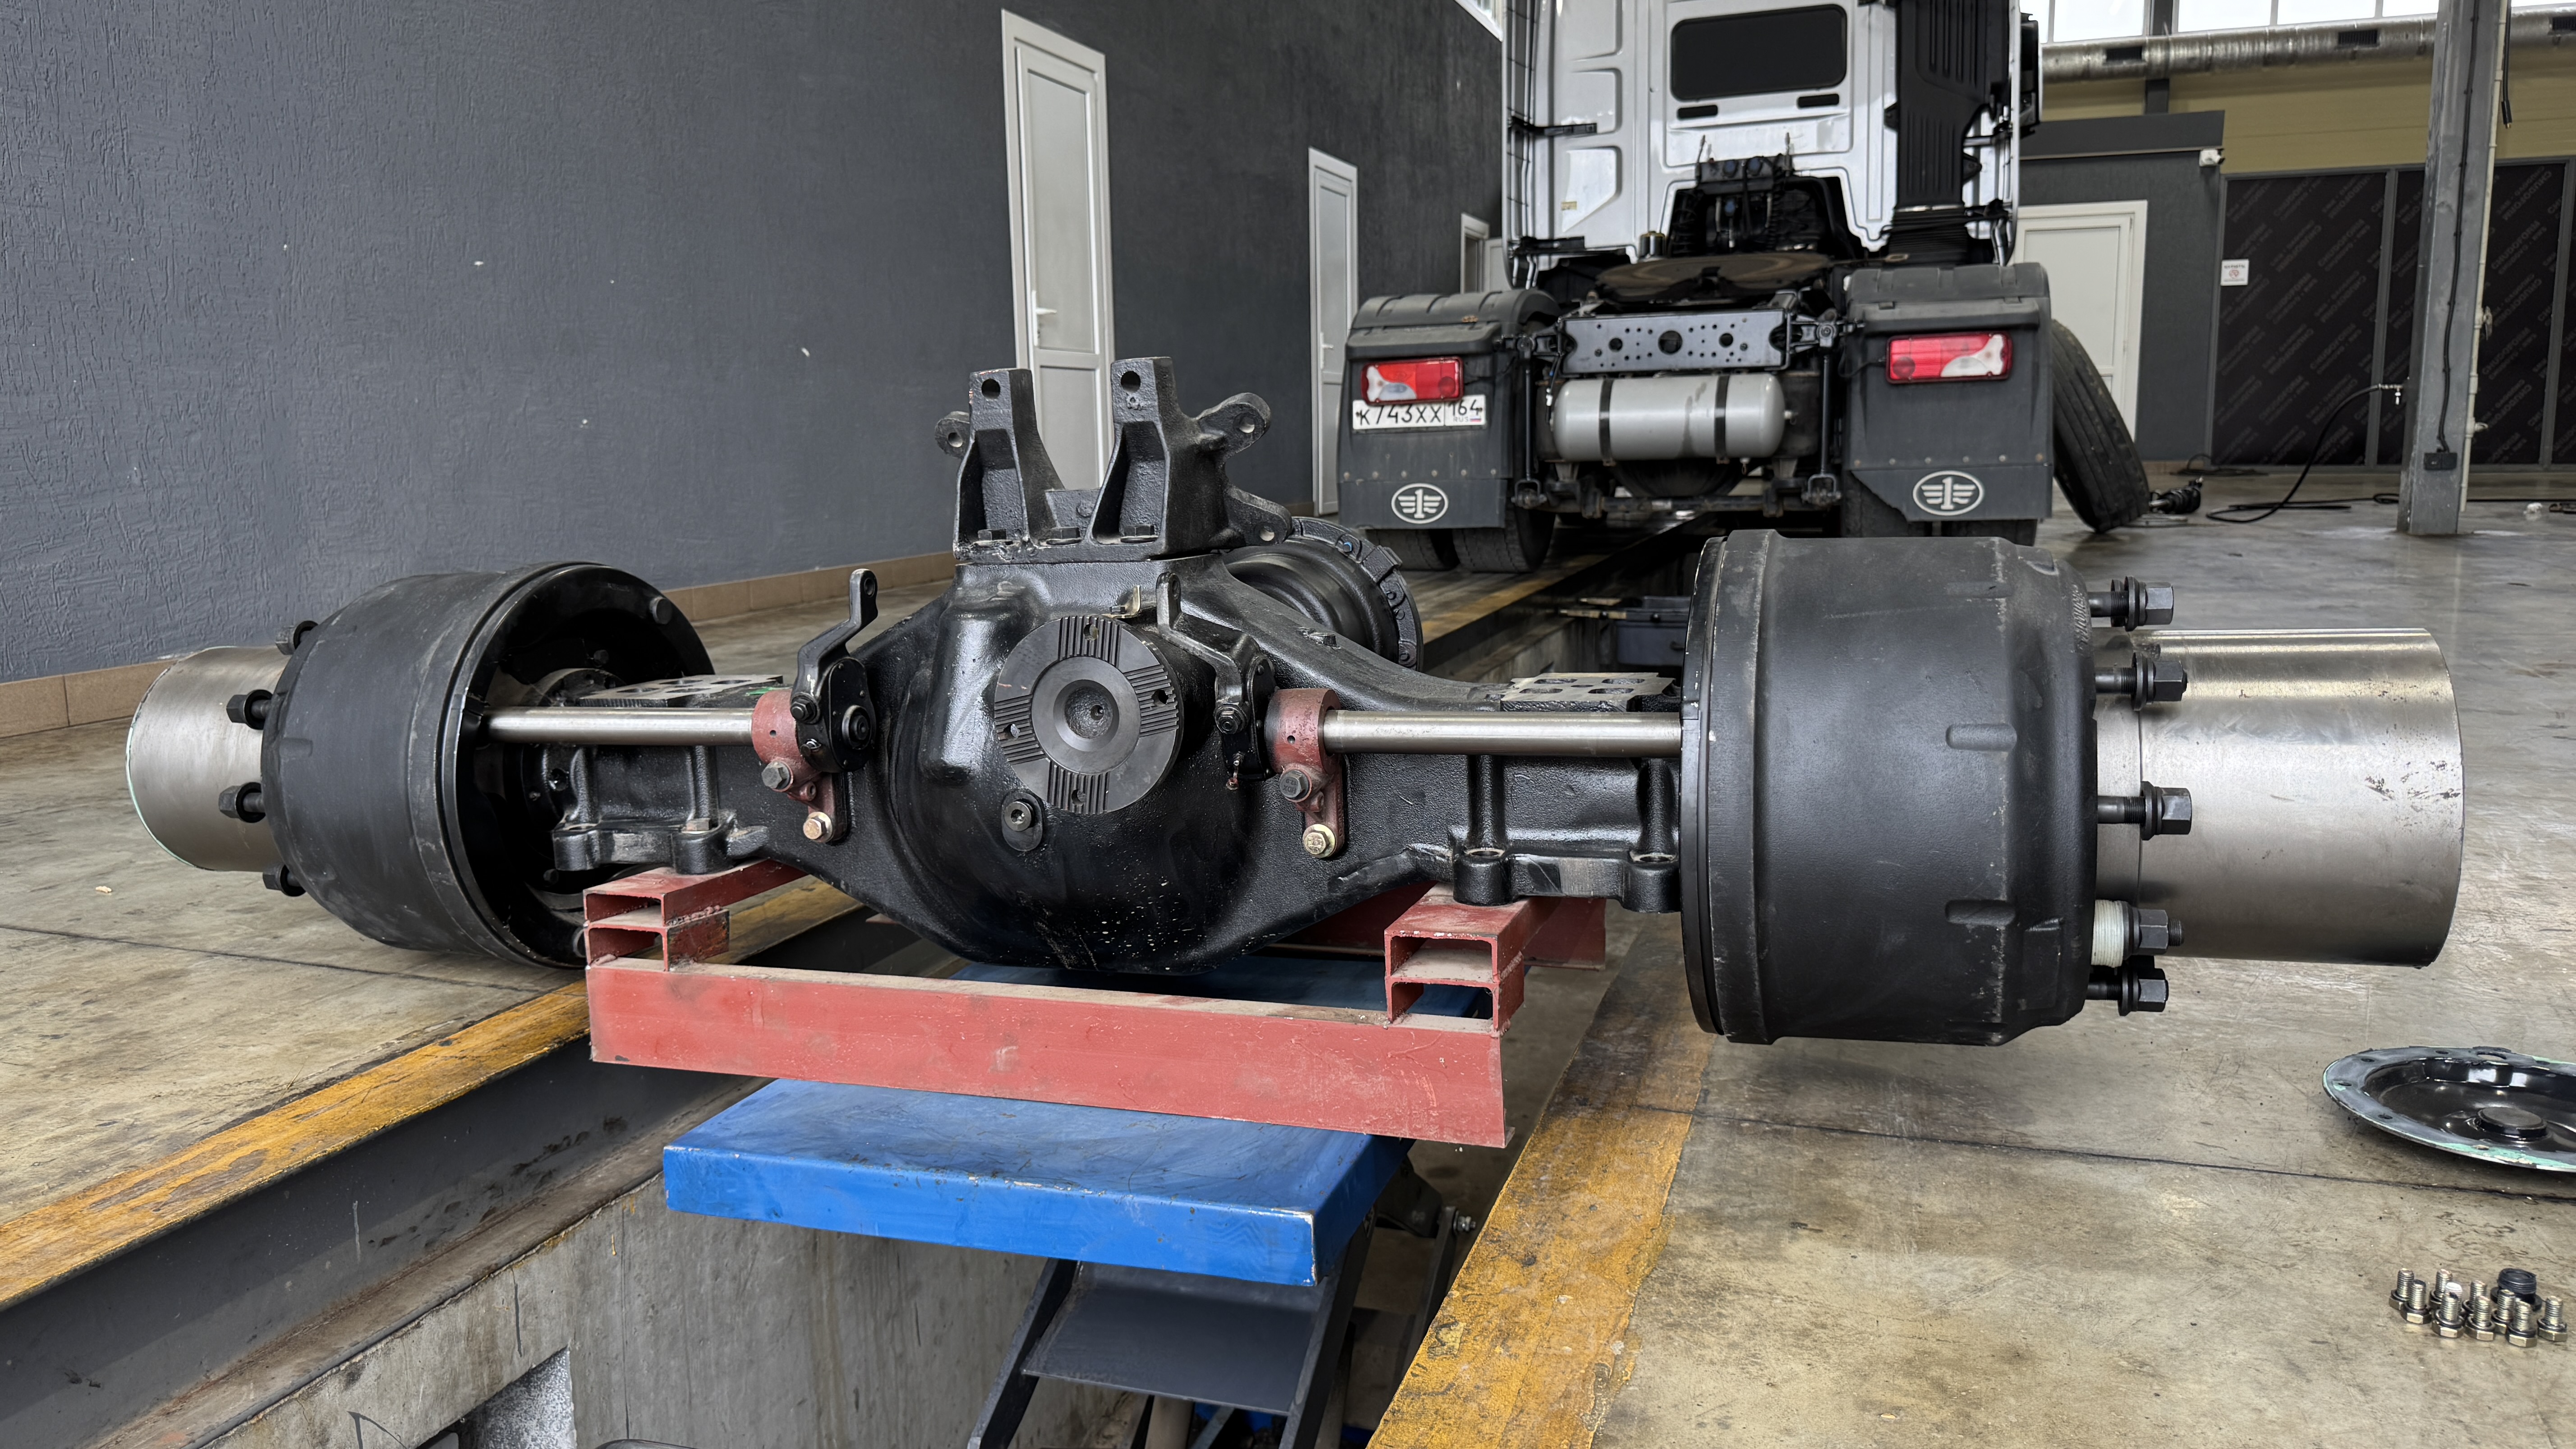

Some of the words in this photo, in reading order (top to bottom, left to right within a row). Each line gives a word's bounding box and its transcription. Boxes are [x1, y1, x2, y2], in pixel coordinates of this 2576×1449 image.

[2503, 171, 2551, 220] CHUDOFORM
[2491, 220, 2539, 269] CHUDOFORM
[2482, 326, 2530, 375] CHUDOFORM
[1448, 400, 1481, 416] 164
